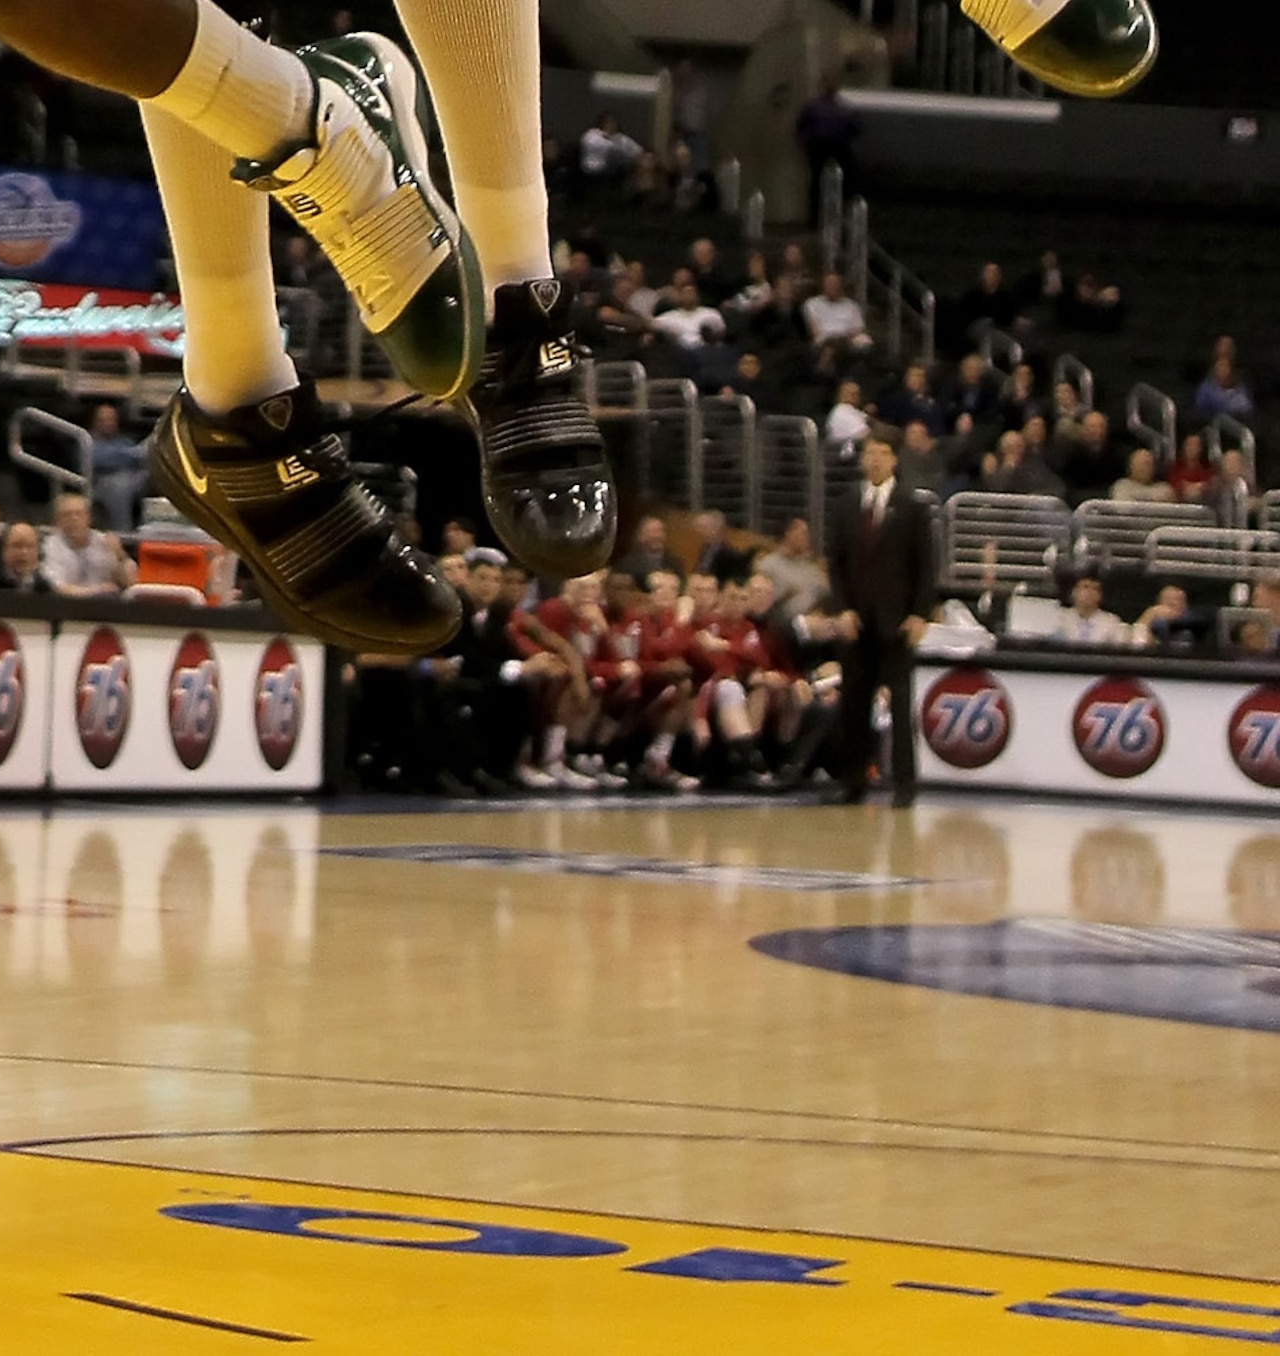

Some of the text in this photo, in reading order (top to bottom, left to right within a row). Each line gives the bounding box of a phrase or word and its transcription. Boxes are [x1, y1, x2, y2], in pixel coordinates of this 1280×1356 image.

[78, 654, 130, 737] 76
[928, 687, 1005, 747] 76
[1079, 696, 1159, 756] 76
